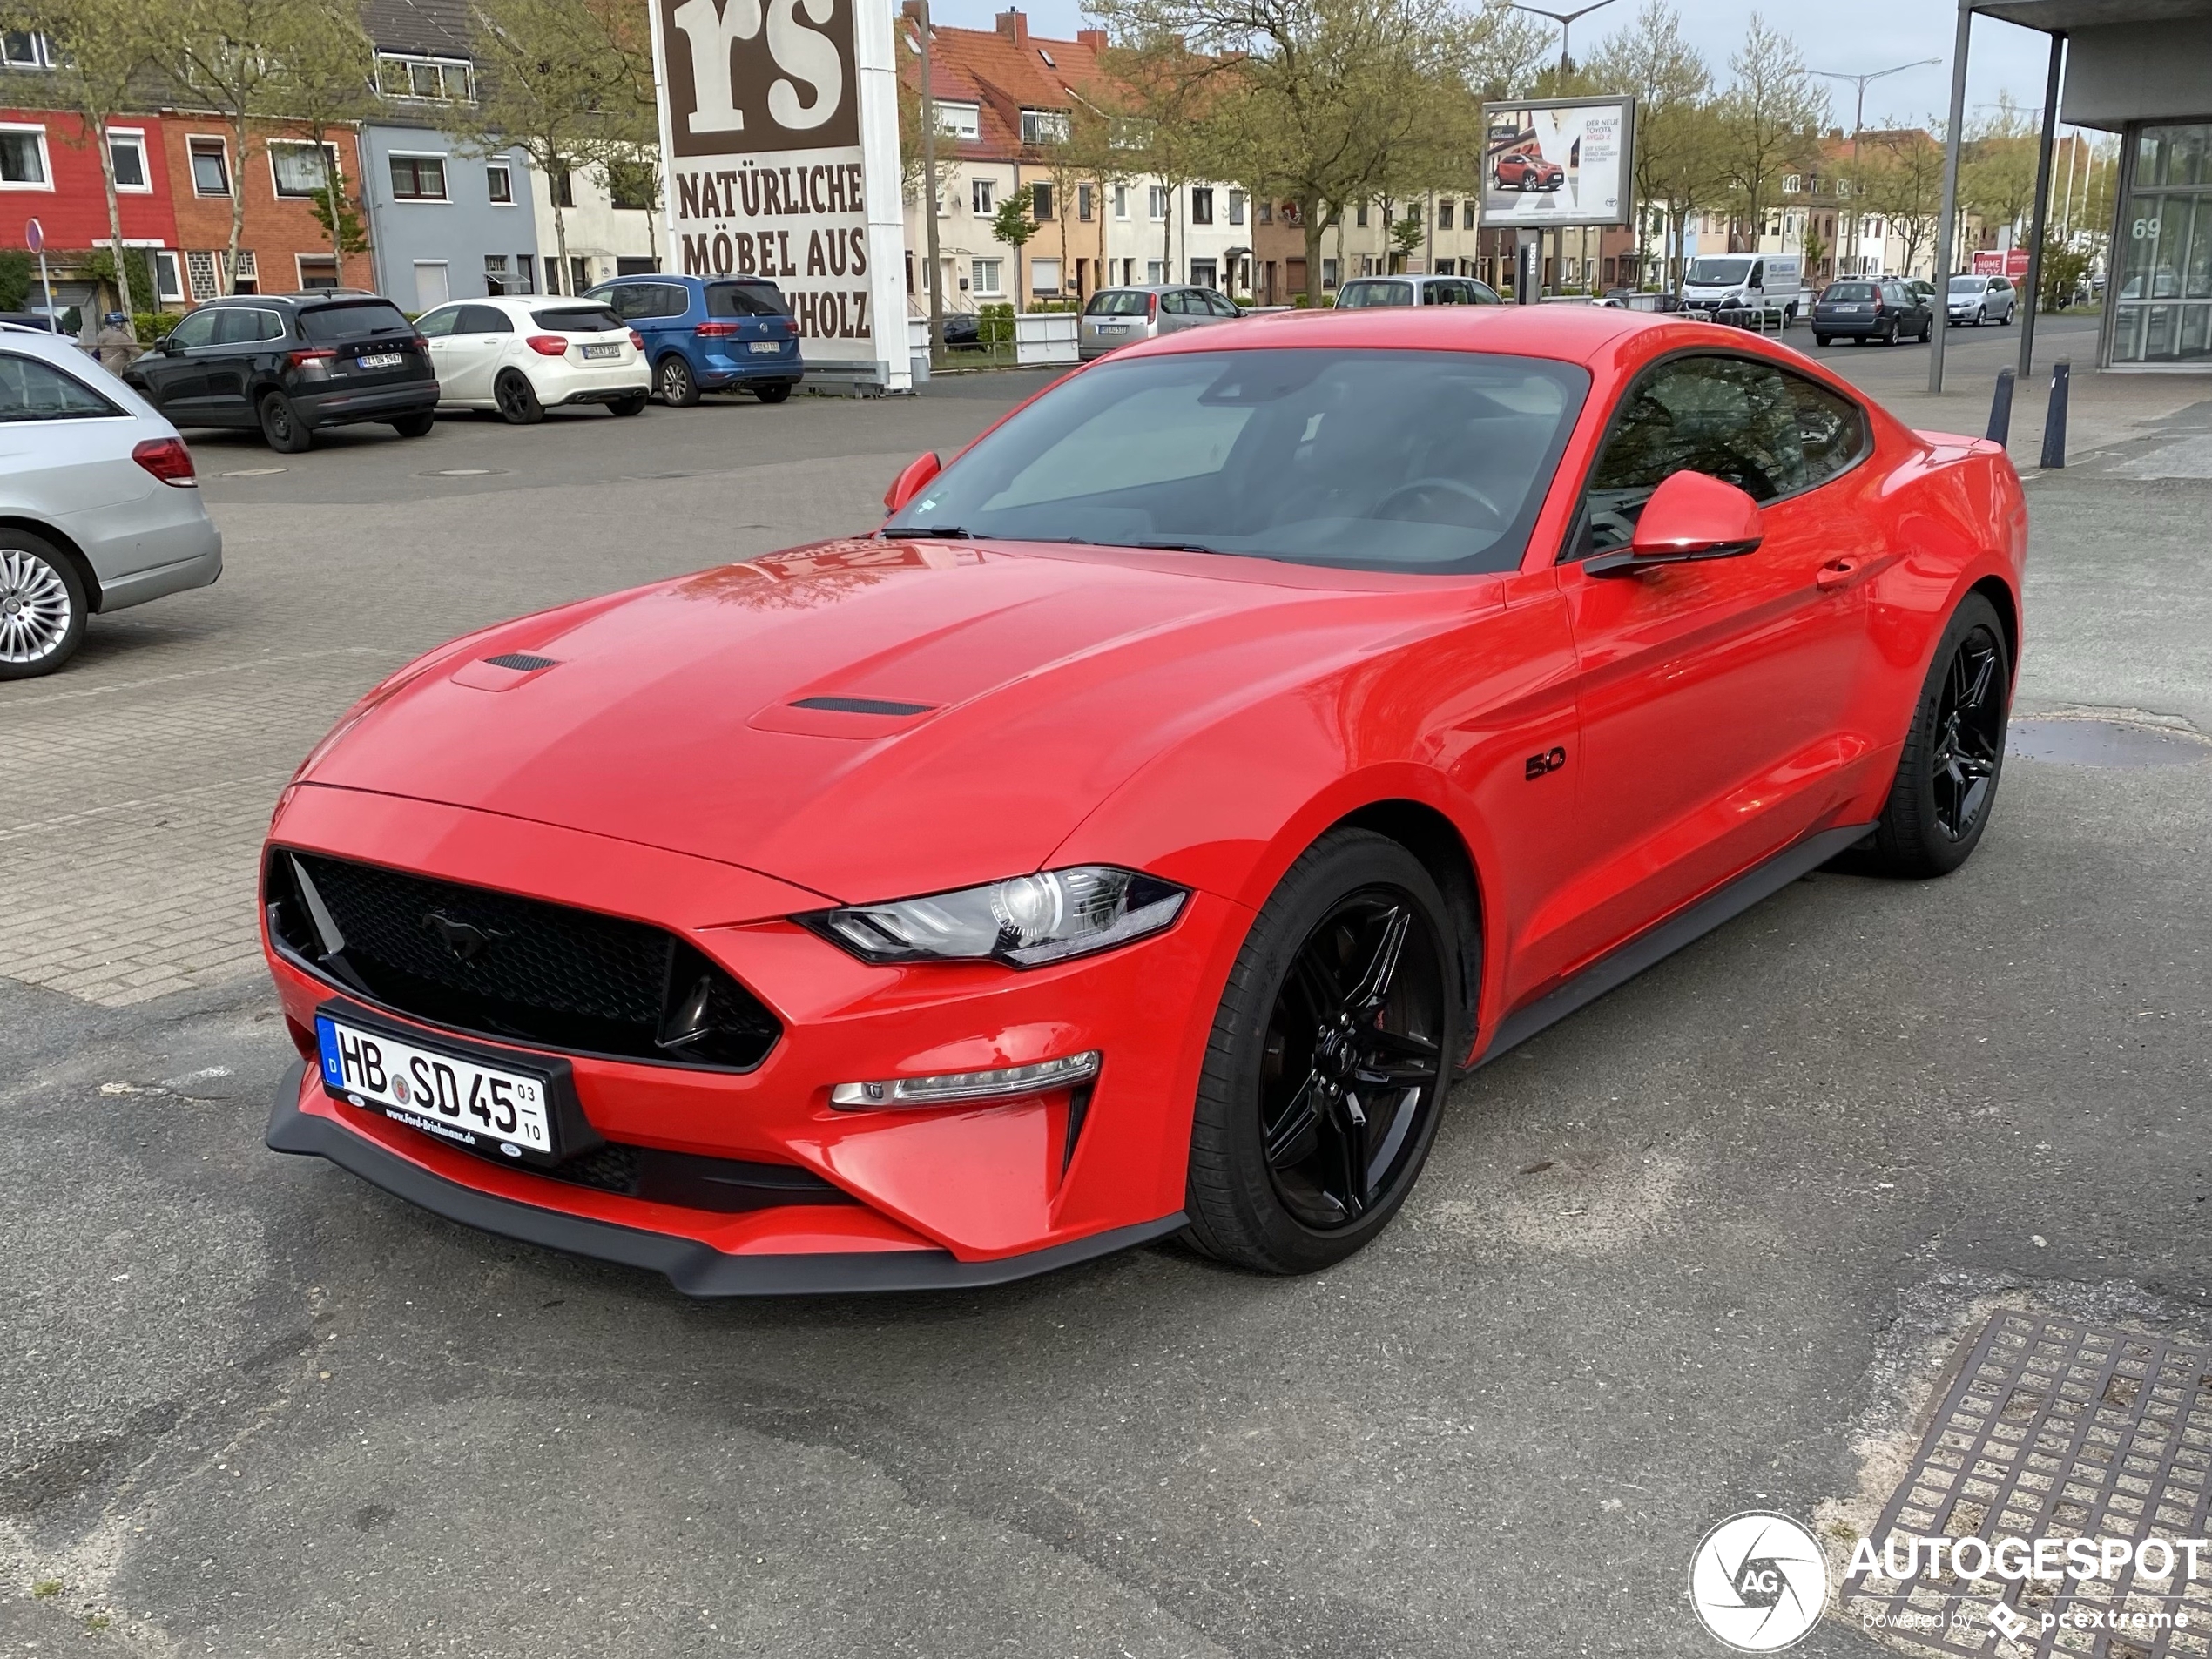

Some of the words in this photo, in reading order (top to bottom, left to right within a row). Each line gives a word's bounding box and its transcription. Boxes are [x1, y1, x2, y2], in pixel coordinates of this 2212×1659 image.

[674, 0, 842, 133] rs
[676, 159, 864, 219] NATÜRLICHE
[2132, 218, 2161, 239] 69
[681, 223, 797, 277] MÖBEL
[806, 226, 867, 277] AUS
[1978, 260, 2000, 268] HOME
[386, 353, 401, 363] 1967
[587, 347, 596, 355] HB
[607, 346, 618, 354] 124
[328, 1058, 337, 1074] D
[339, 1031, 387, 1094] HB
[409, 1055, 460, 1118] SD
[469, 1073, 517, 1134] 45
[517, 1083, 536, 1102] 03
[385, 1109, 475, 1145] www.Ford-Brinkmann.de
[524, 1123, 541, 1141] 10
